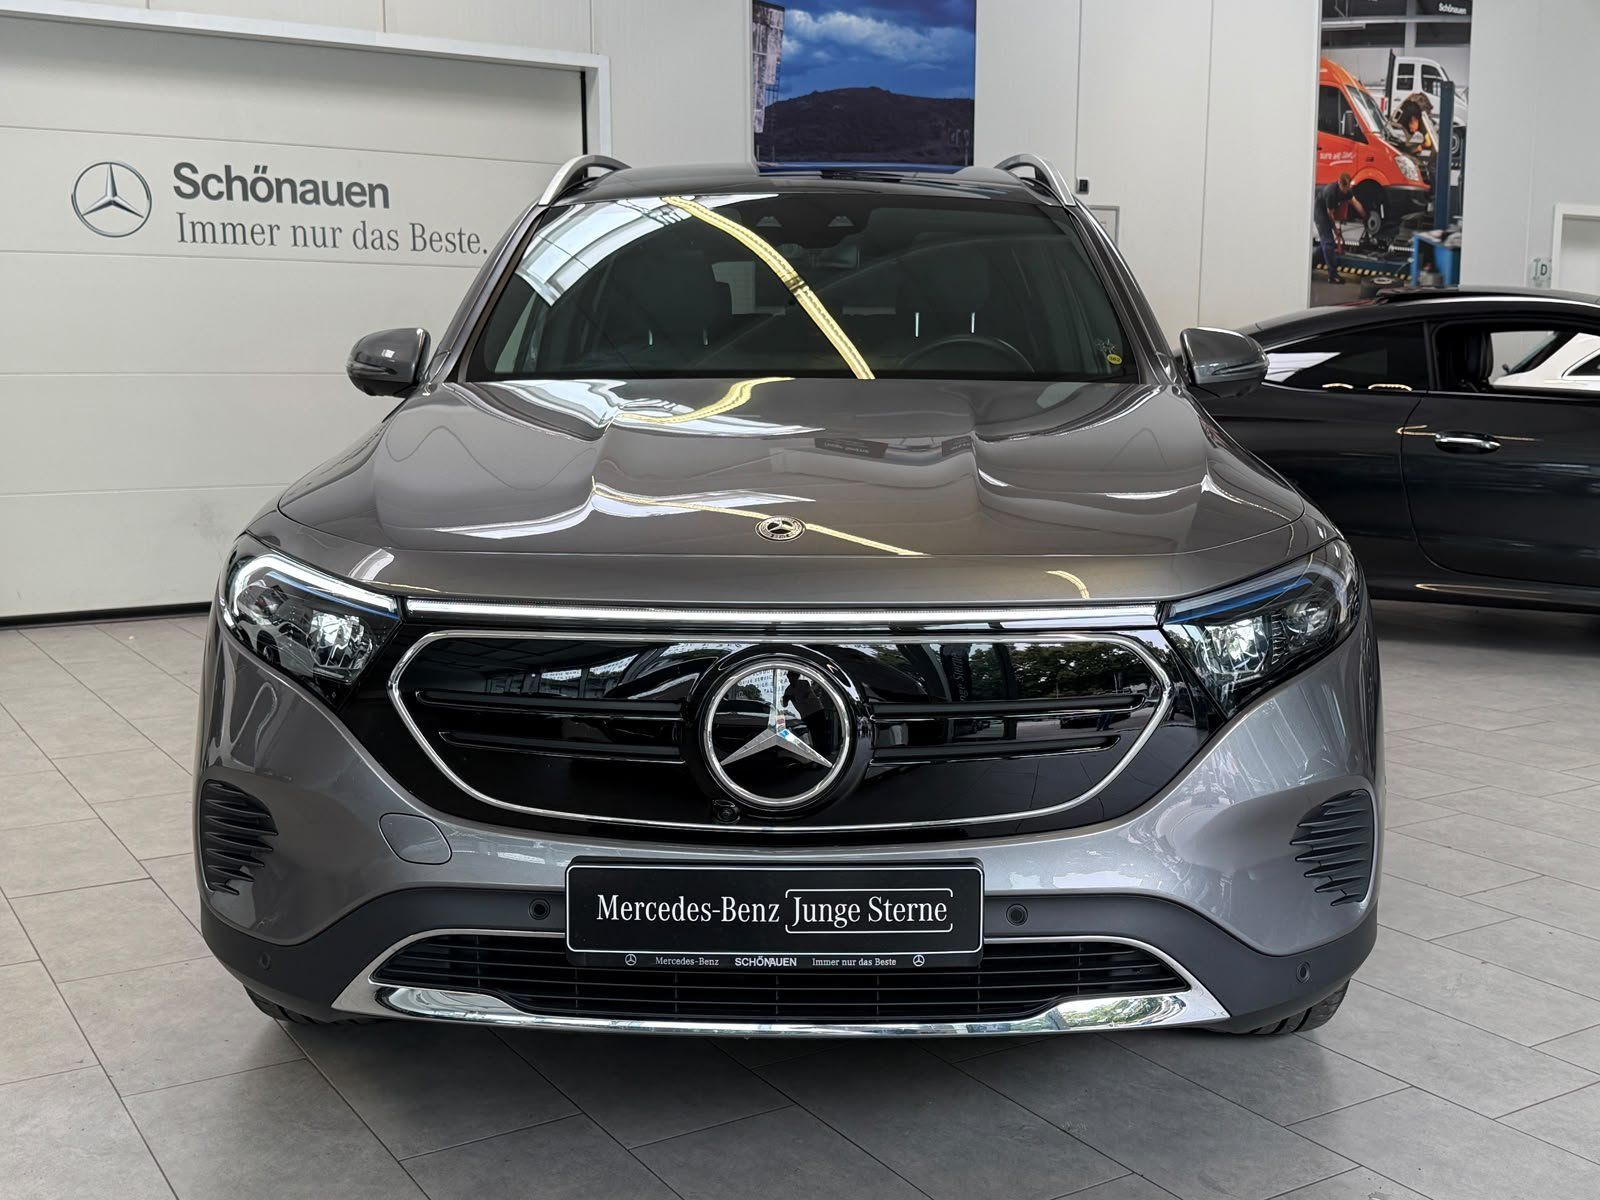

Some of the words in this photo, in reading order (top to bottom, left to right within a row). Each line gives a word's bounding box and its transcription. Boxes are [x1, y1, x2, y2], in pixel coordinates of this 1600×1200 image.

[172, 161, 391, 209] Schönauen
[176, 212, 281, 247] Immer
[290, 225, 343, 250] nur
[351, 220, 401, 252] das
[409, 222, 489, 256] Beste.
[596, 894, 780, 923] Mercedes-Benz
[791, 896, 861, 929] Junge
[868, 895, 948, 923] Sterne
[655, 956, 720, 967] Mercedes-Benz
[812, 957, 840, 967] Immer
[841, 958, 856, 967] nur
[858, 957, 873, 967] das
[874, 957, 897, 967] Beste
